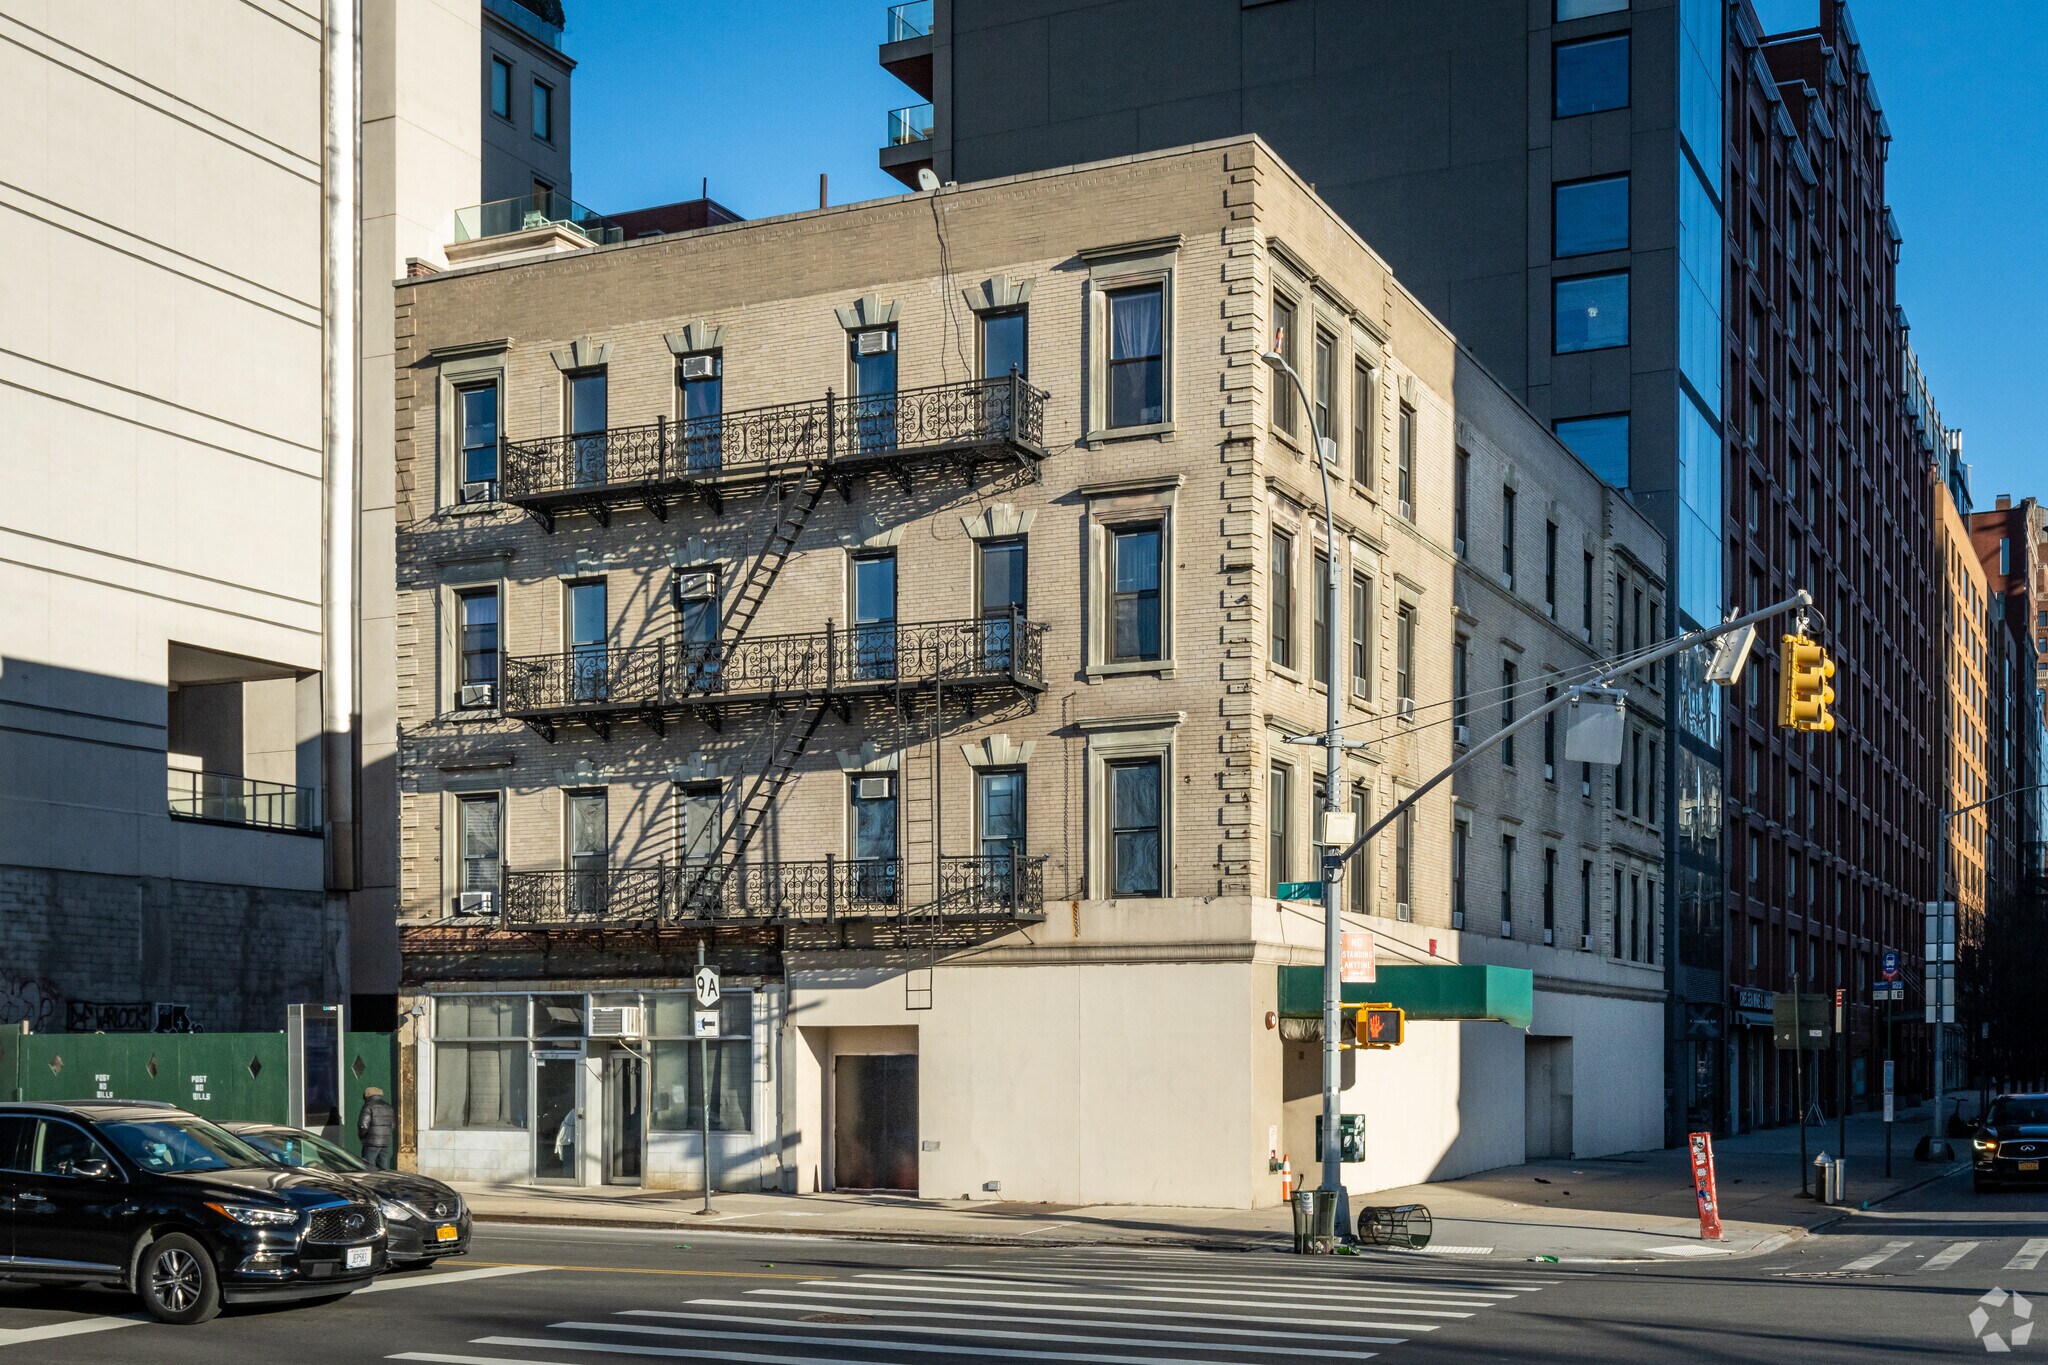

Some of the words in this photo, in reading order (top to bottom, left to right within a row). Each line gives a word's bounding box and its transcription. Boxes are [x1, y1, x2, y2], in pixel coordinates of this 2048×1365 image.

[1291, 884, 1299, 898] 11
[1351, 938, 1363, 948] NO
[1342, 950, 1373, 959] STANDING
[1344, 961, 1372, 969] ANYTIME
[697, 976, 718, 998] 9A
[95, 1074, 110, 1082] POST
[191, 1075, 207, 1083] POST
[99, 1082, 107, 1090] NO
[96, 1091, 113, 1099] BILLS
[192, 1093, 211, 1101] BILLS
